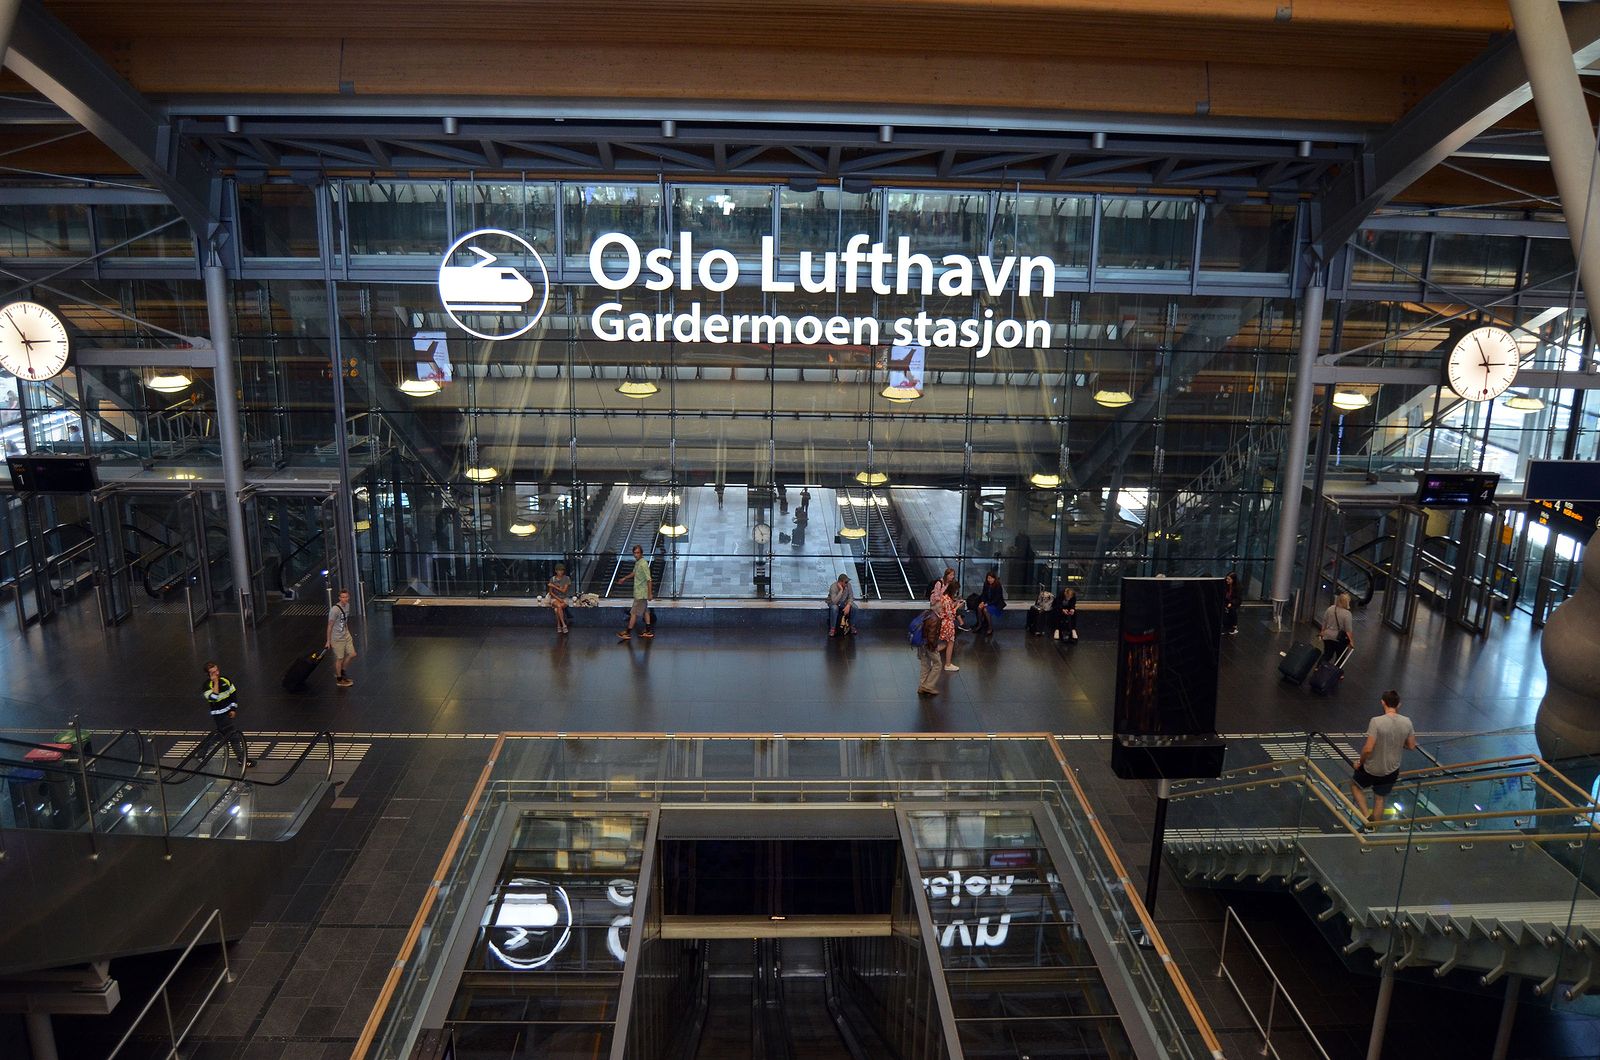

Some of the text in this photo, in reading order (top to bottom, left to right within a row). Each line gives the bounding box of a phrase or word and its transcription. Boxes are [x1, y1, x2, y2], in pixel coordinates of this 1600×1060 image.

[589, 232, 1056, 298] Oslo Lufthavn
[591, 302, 1052, 358] Gardermoen stasjon
[1480, 490, 1488, 500] 4
[1554, 500, 1561, 511] 4
